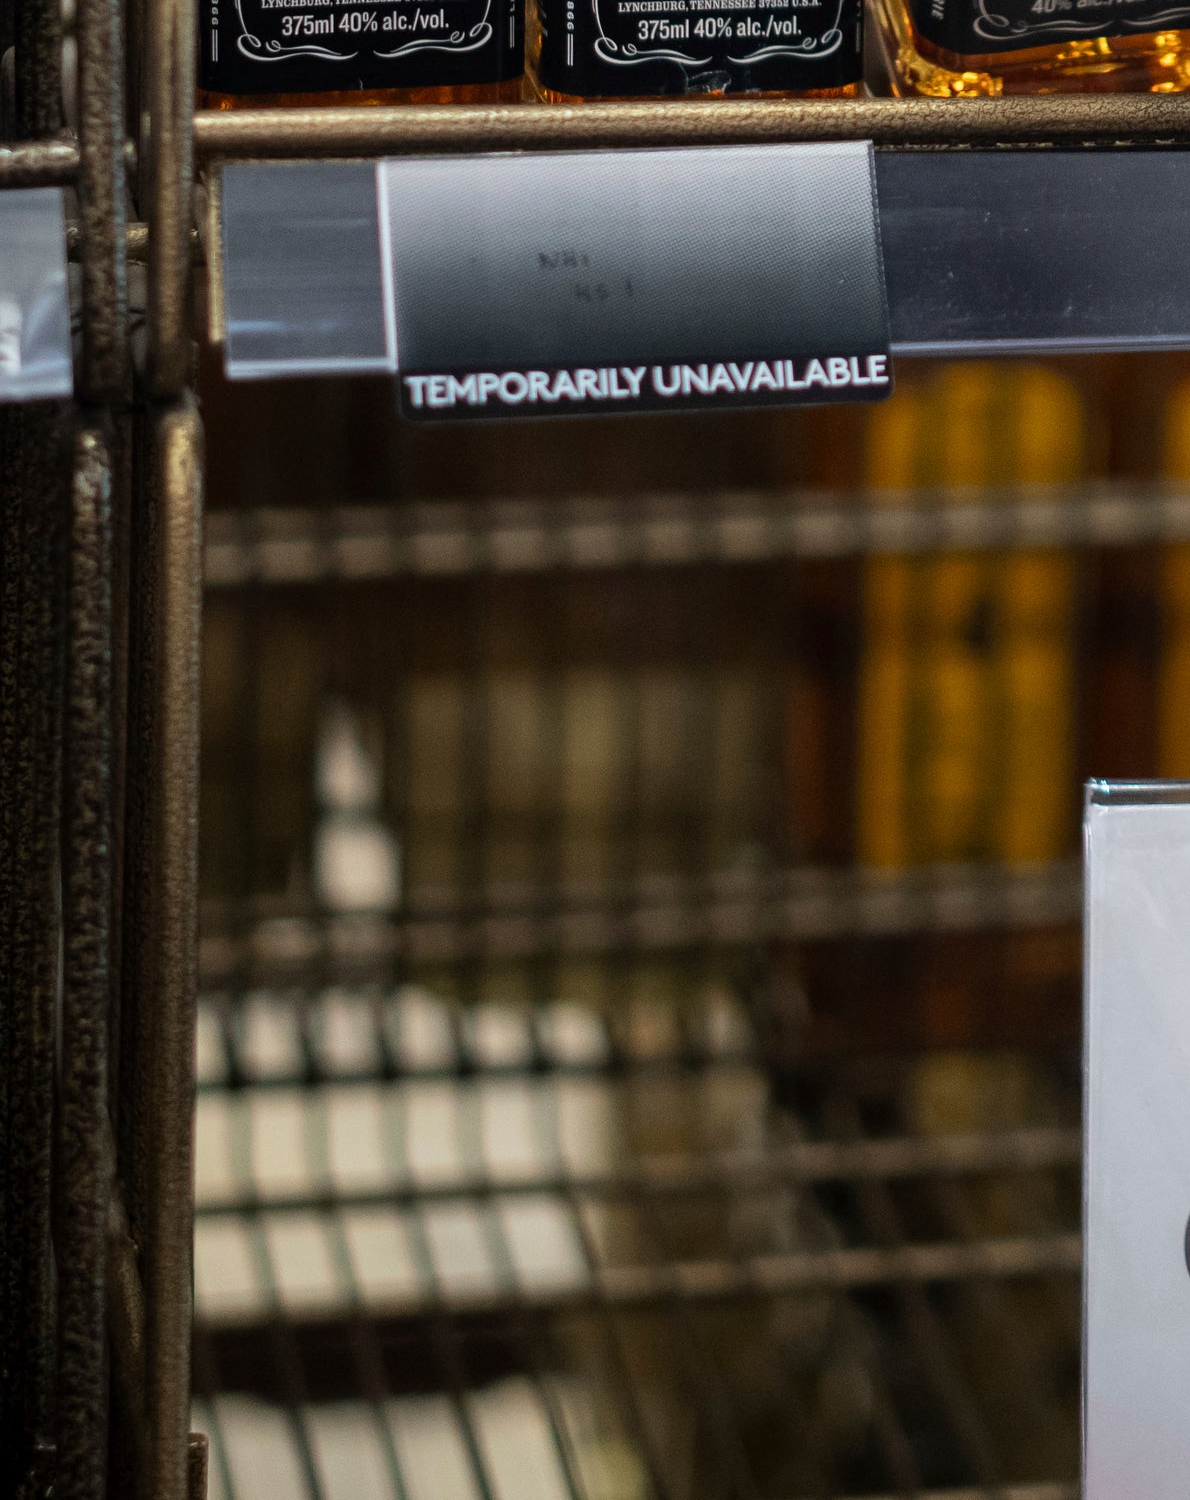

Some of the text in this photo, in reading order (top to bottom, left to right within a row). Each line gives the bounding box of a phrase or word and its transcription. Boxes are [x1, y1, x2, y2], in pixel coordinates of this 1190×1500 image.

[619, 0, 688, 13] LYNCHBURG,
[282, 9, 449, 35] 375ml 40% alc./vol.
[638, 15, 801, 39] 375ml 40% alc./vol.
[404, 354, 889, 408] TEMPORARILY UNAVAILABLE
